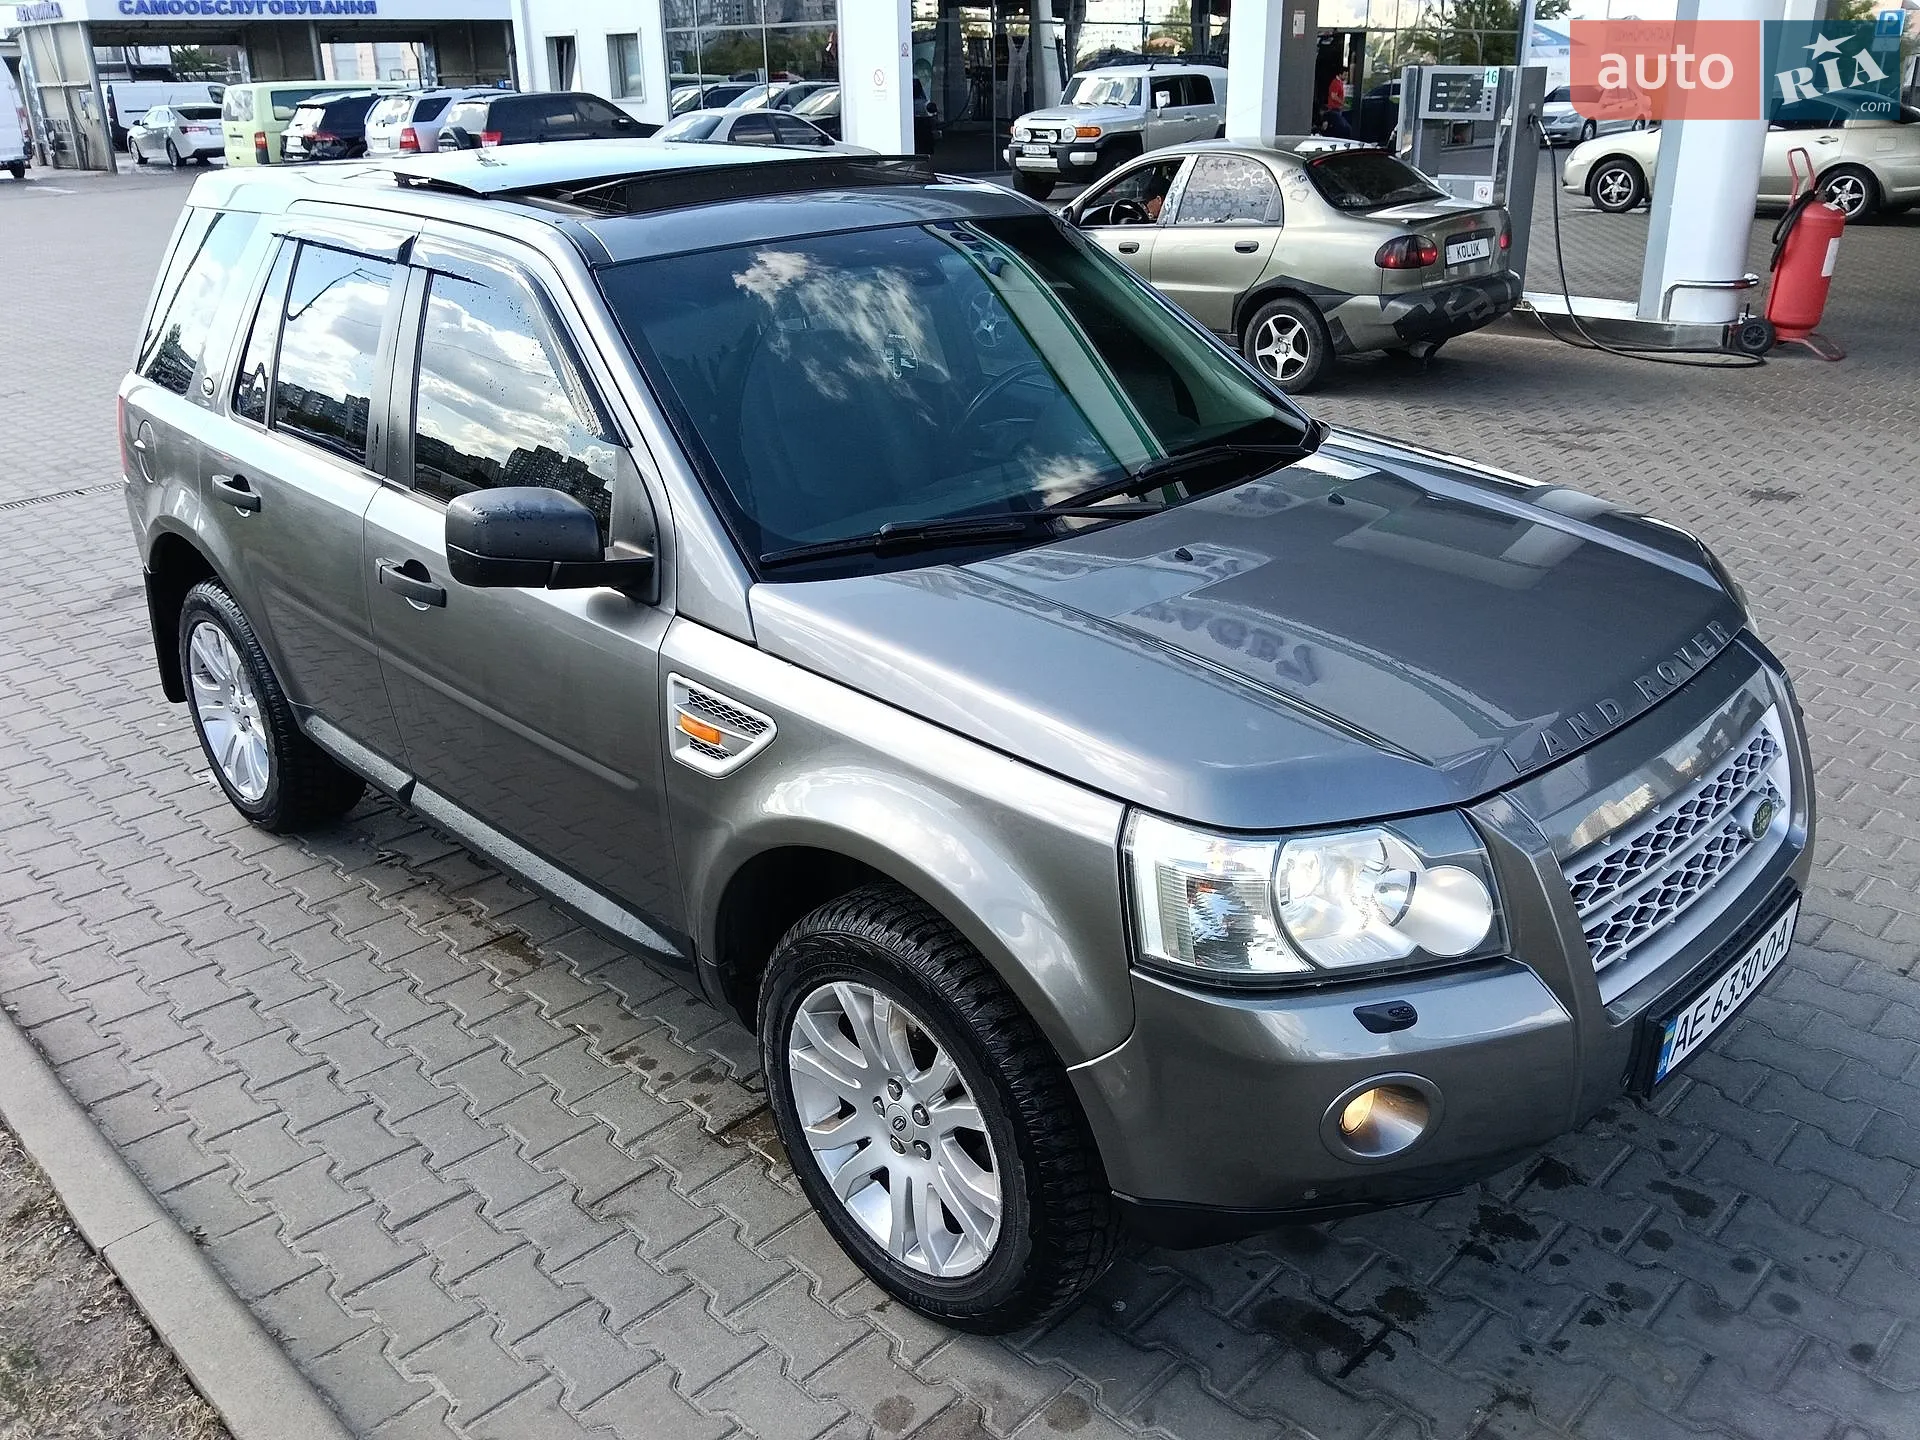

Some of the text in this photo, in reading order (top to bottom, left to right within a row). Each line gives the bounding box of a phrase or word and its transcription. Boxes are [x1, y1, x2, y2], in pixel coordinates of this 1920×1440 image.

[118, 0, 377, 15] САМООБСЛУГОВУВАННЯ
[1486, 70, 1498, 83] 16
[1457, 242, 1481, 260] KOLUK
[1503, 620, 1731, 774] LAND ROVER
[1670, 917, 1788, 1063] AE 6330 OA
